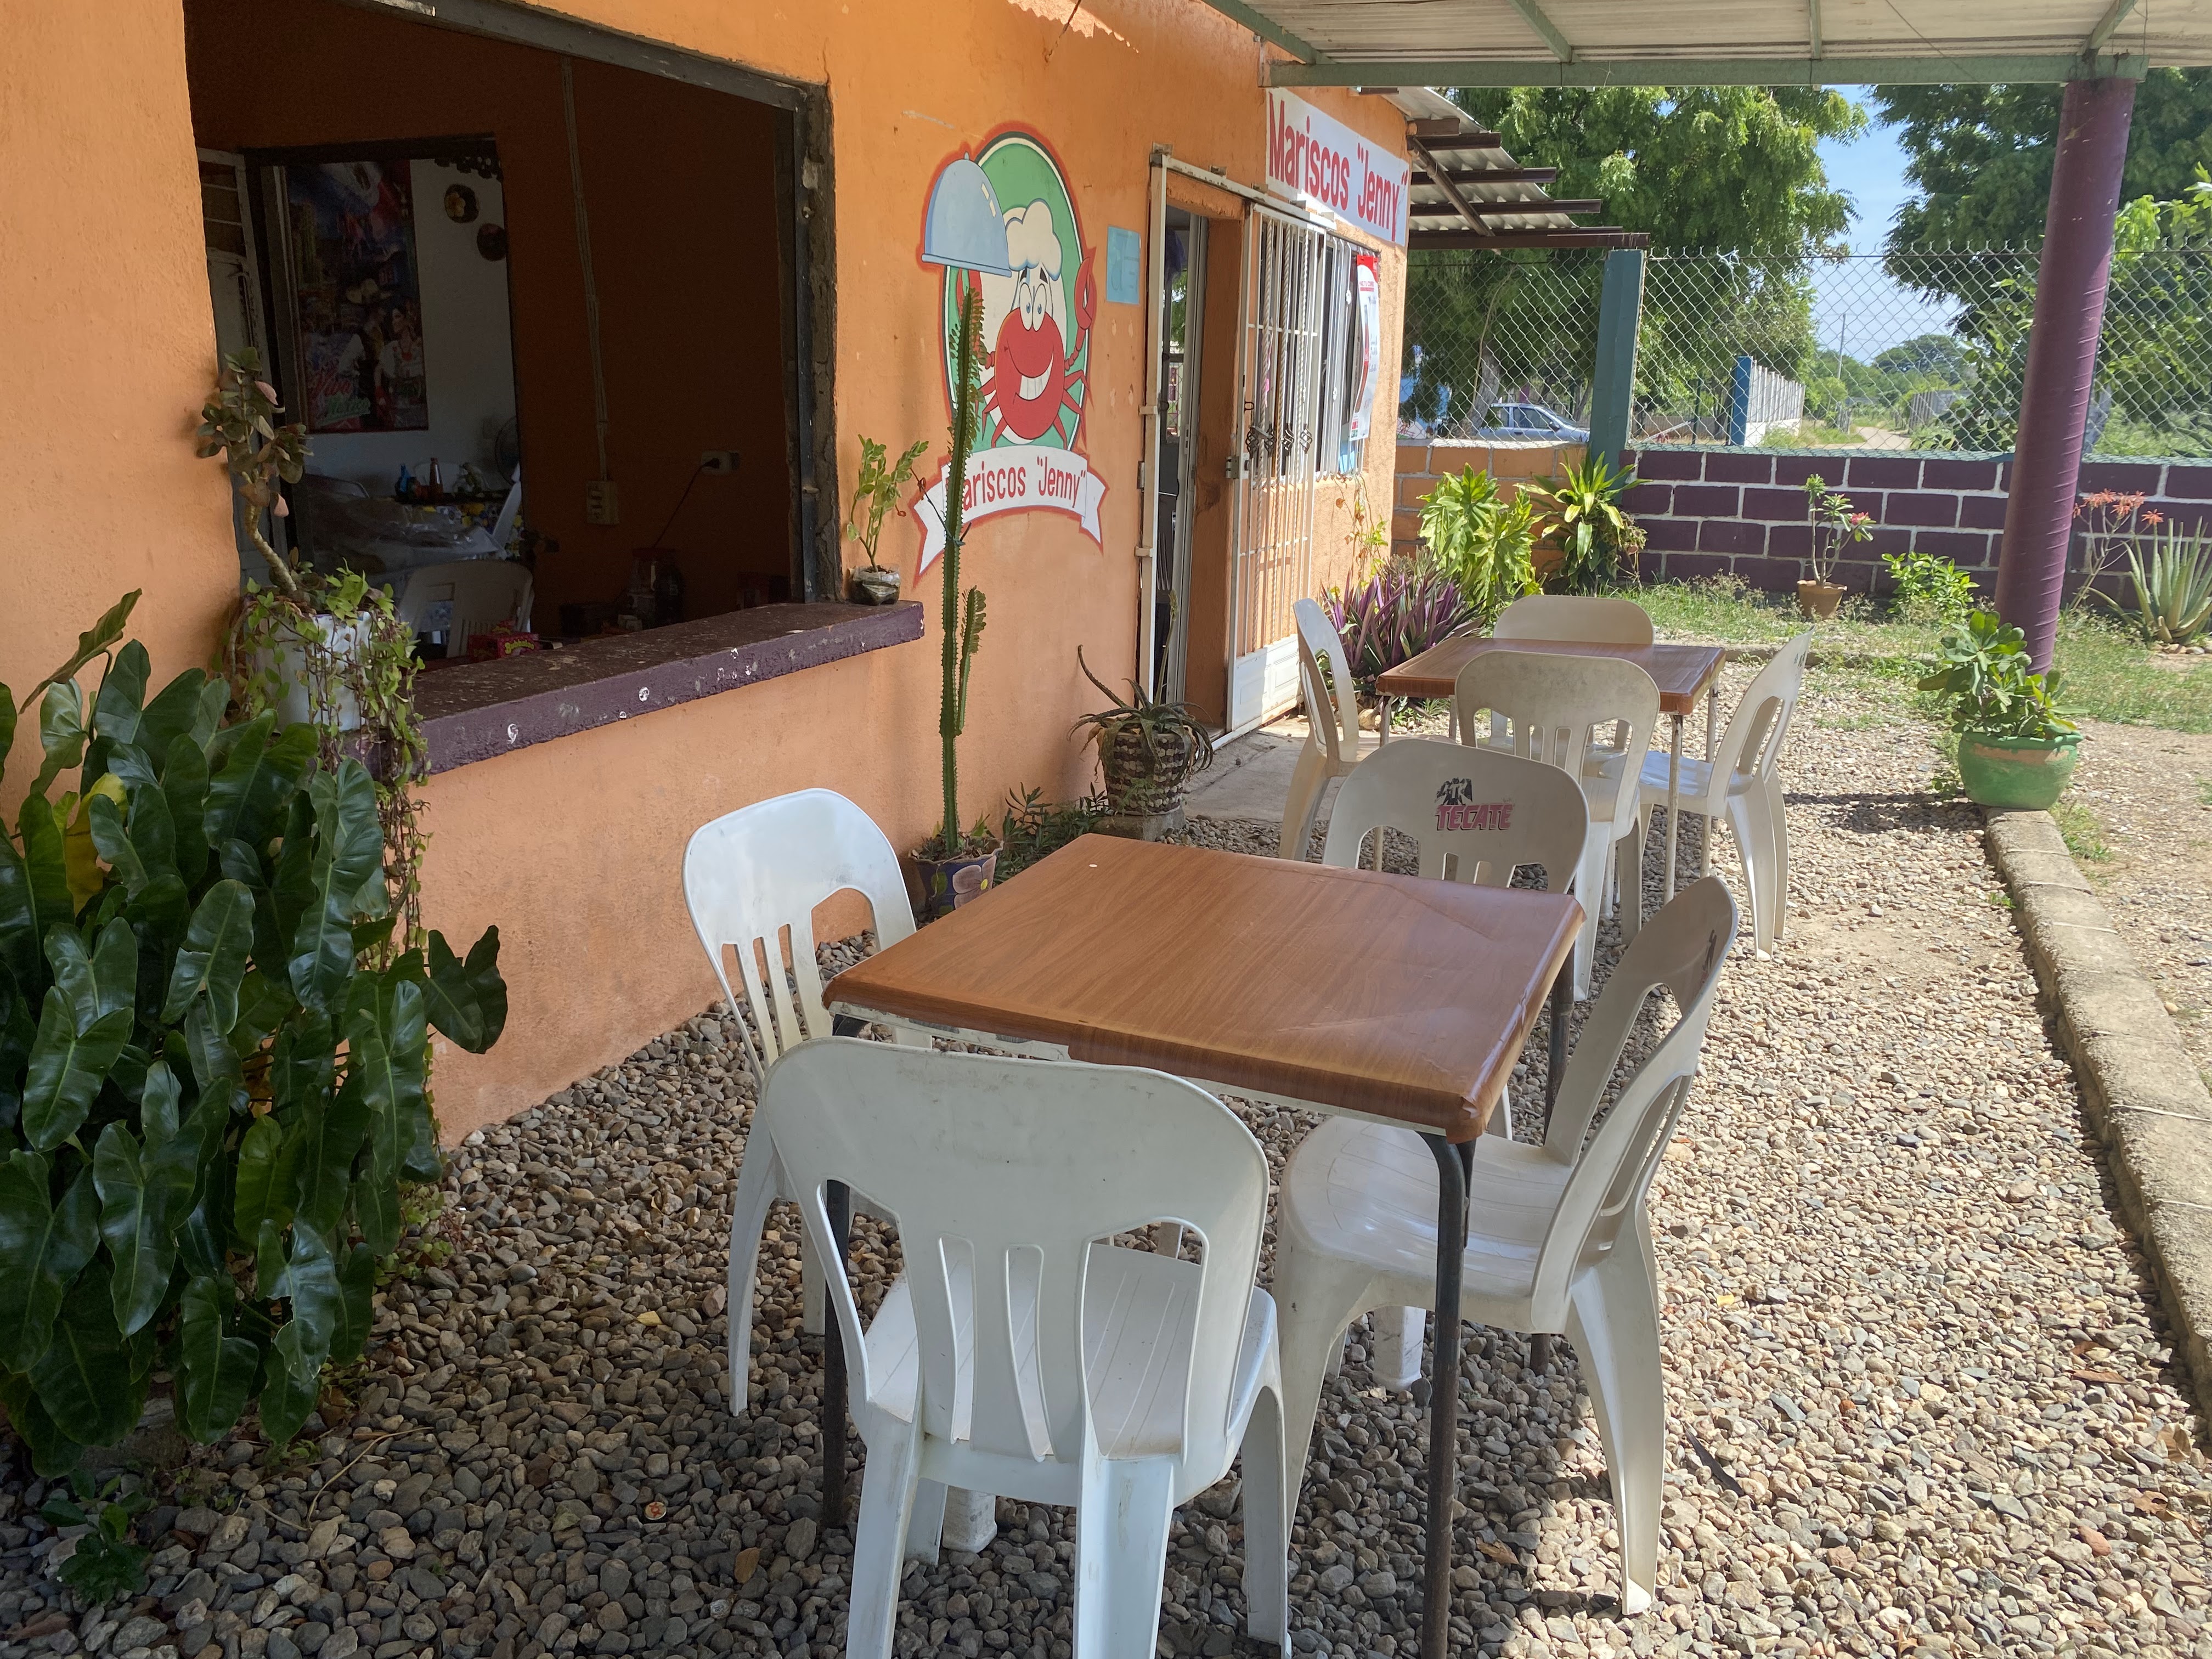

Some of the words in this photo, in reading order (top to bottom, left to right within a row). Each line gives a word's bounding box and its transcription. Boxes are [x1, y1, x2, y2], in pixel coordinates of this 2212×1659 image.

[1268, 92, 1350, 211] Mariscos
[945, 460, 1026, 511] ariscos
[1435, 803, 1513, 831] TECATE
